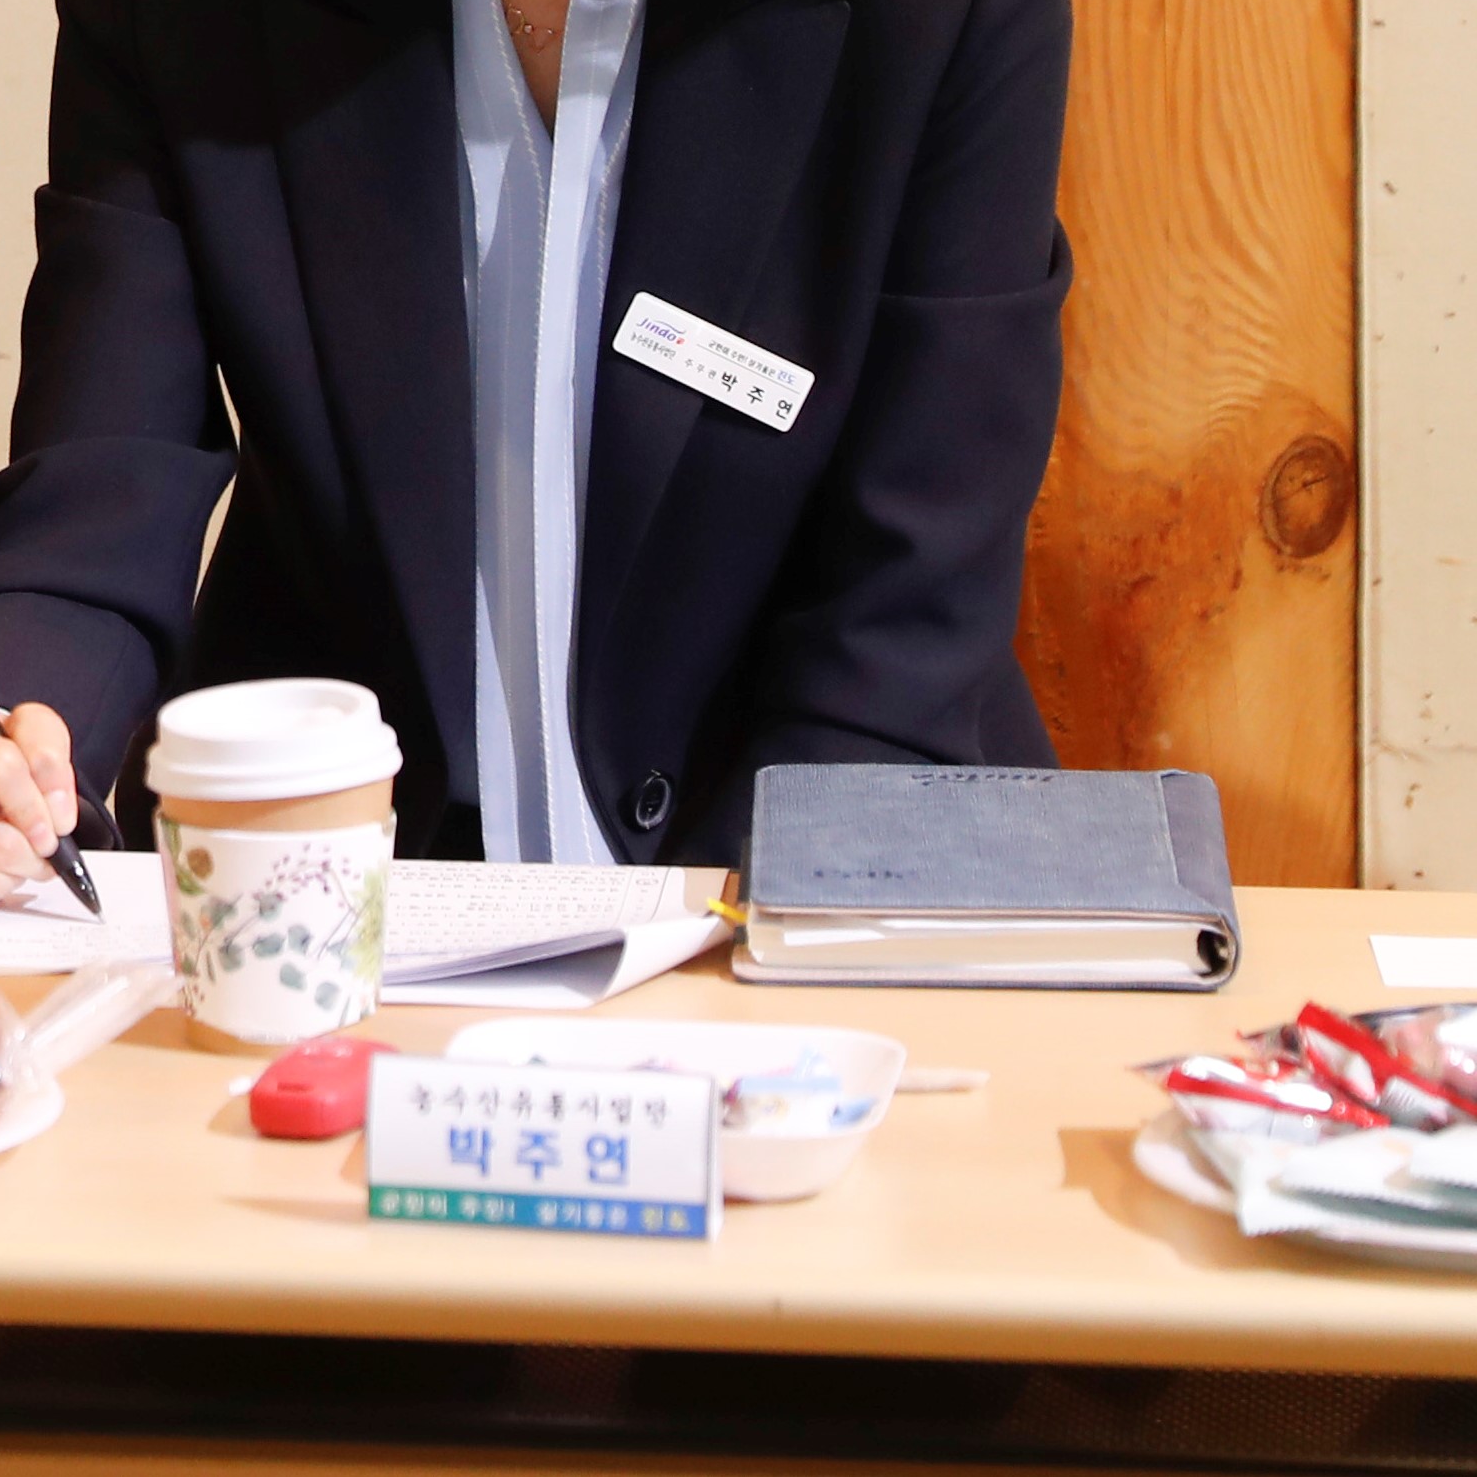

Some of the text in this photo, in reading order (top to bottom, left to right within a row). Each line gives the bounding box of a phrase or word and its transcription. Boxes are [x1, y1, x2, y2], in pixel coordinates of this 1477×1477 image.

[636, 318, 677, 342] Jindo
[776, 369, 797, 385] 진도
[721, 371, 793, 420] 박주연
[448, 1126, 630, 1185] 박주연
